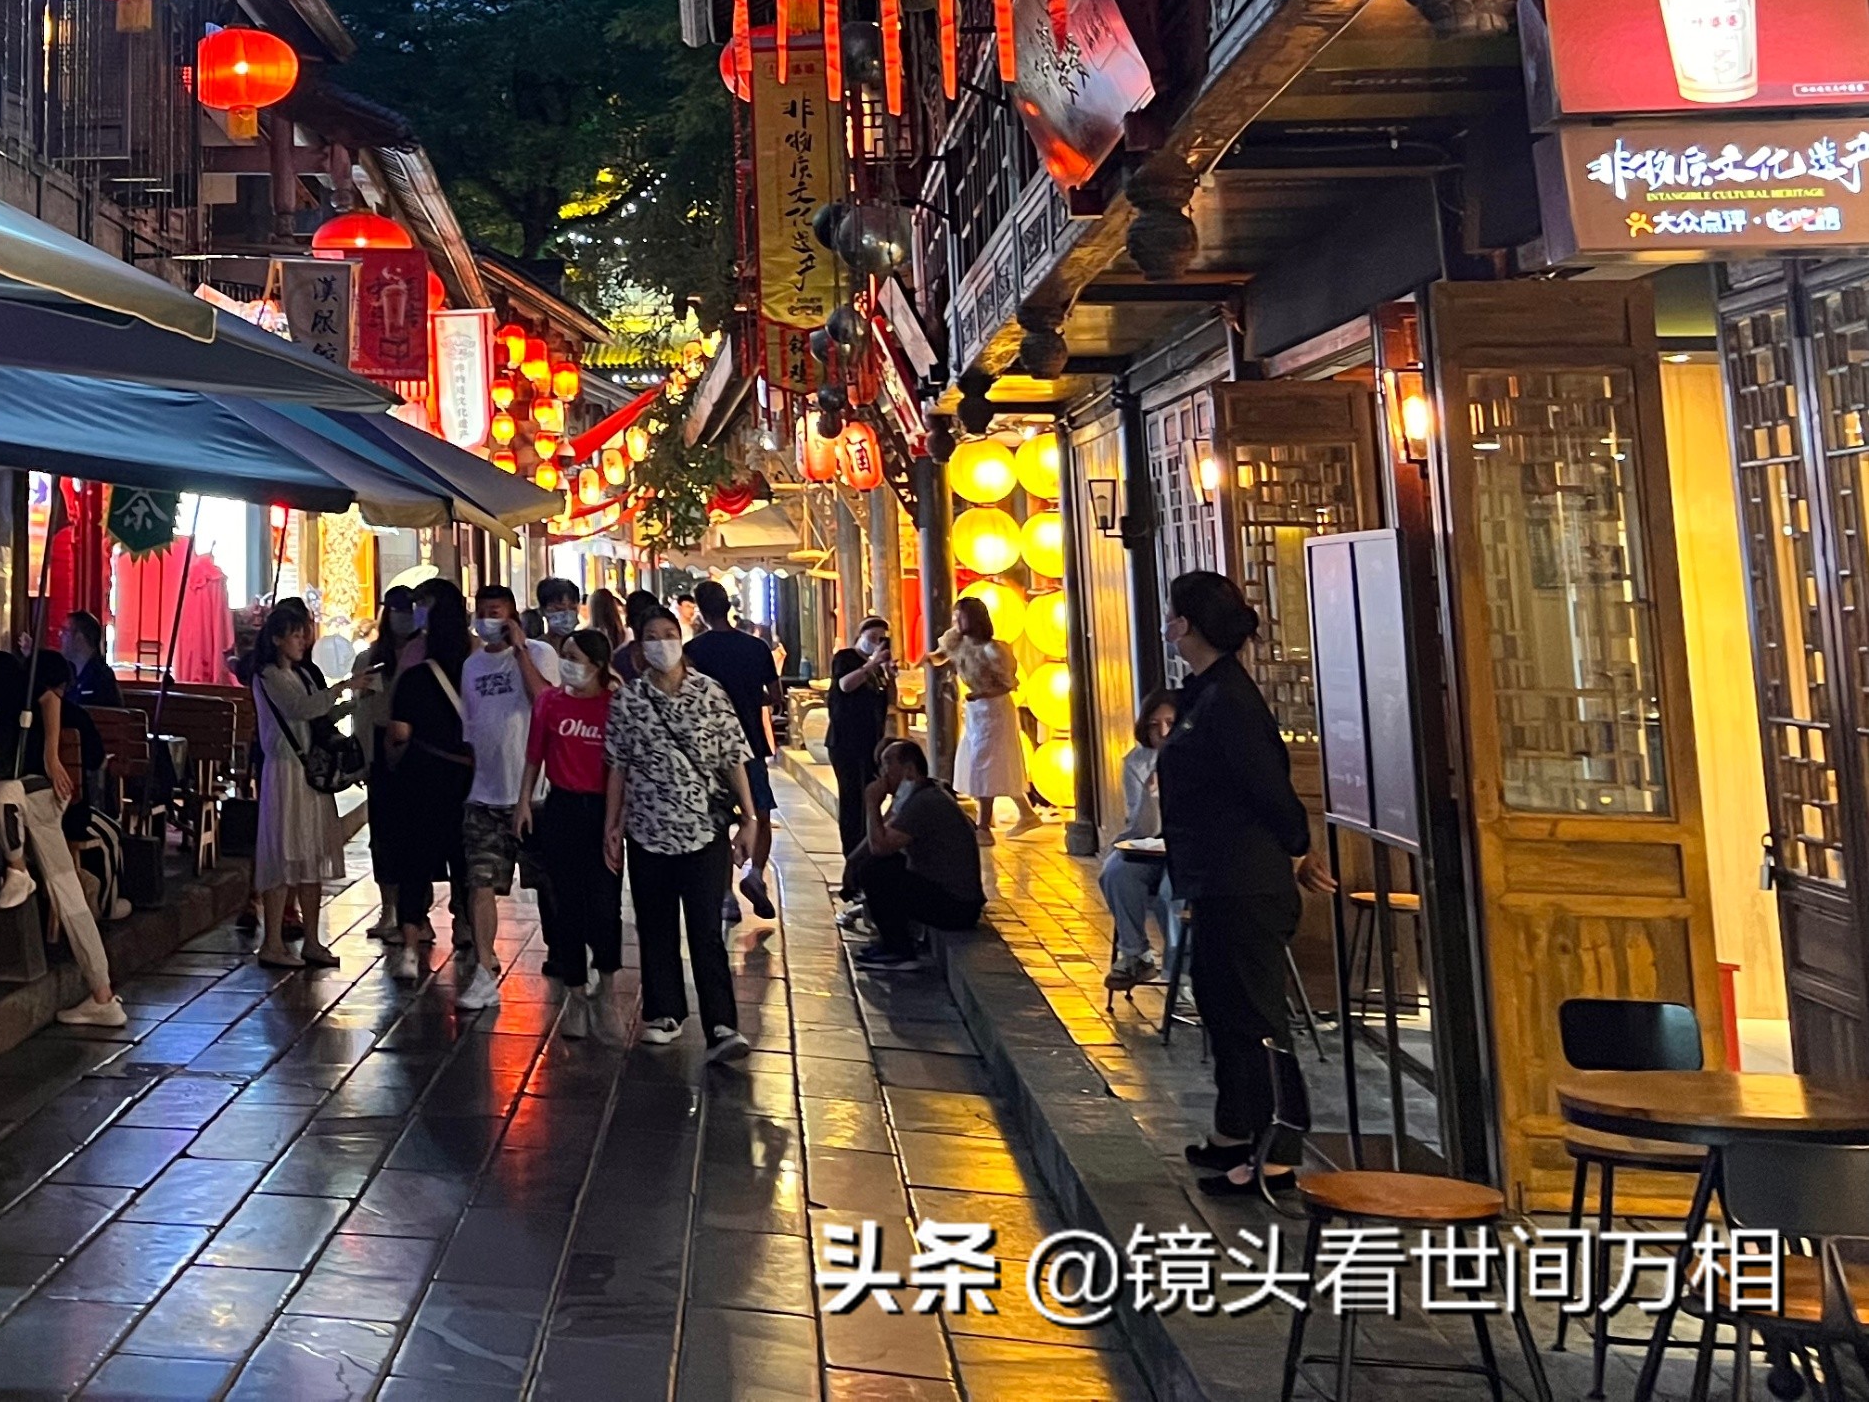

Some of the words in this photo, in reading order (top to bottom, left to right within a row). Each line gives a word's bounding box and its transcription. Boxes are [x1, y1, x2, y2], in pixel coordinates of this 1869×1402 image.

[782, 90, 817, 292] 非物质文化遗产
[1586, 131, 1869, 201] 非物质文化遗产
[1646, 191, 1712, 202] INTANGIBLE
[1712, 189, 1770, 201] CULTURAL
[1771, 187, 1826, 199] HERITAGE
[844, 435, 872, 475] 酒
